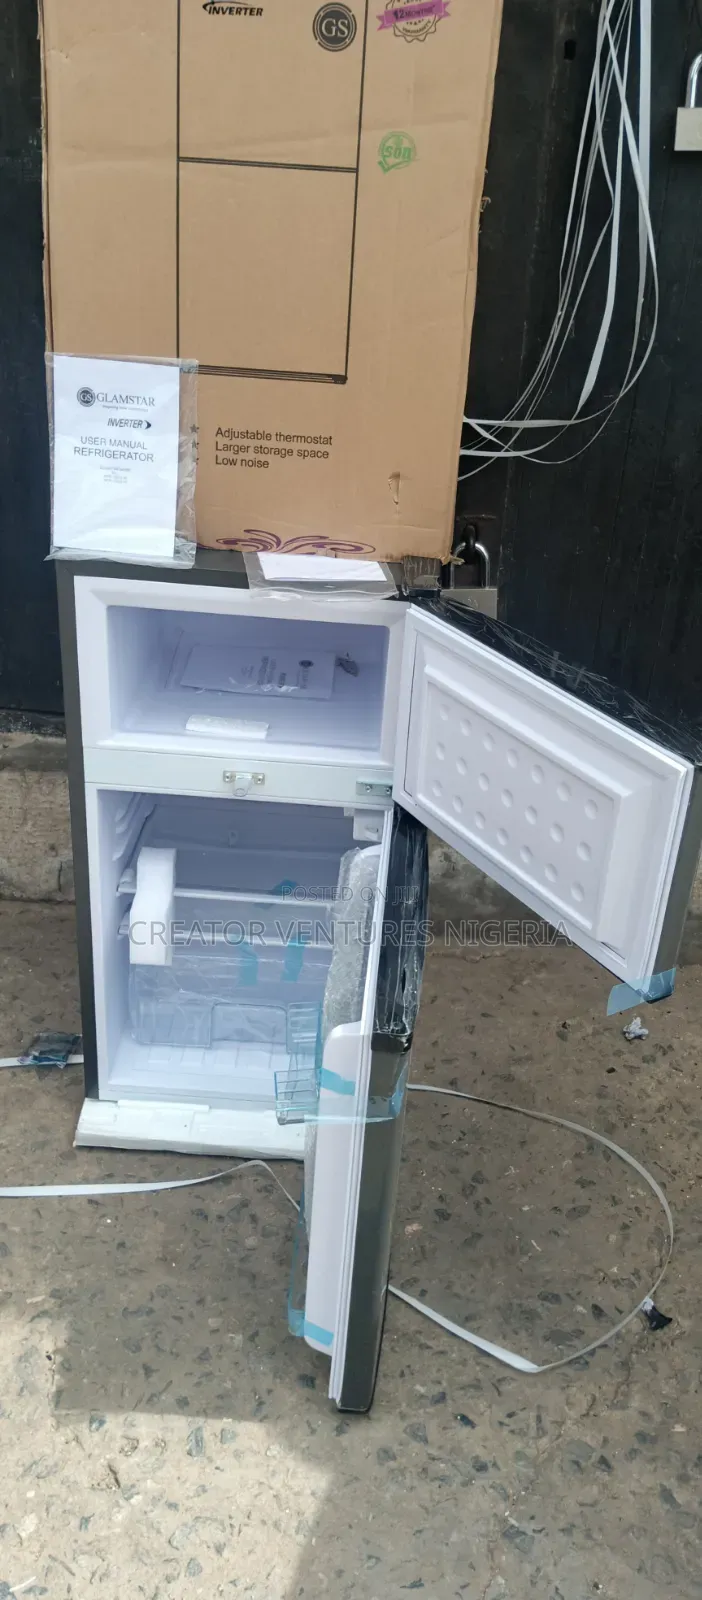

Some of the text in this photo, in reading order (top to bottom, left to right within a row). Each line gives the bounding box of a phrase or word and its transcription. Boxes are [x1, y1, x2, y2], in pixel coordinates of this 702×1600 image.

[208, 6, 264, 17] INVERTER
[321, 18, 349, 38] GS
[96, 392, 155, 407] GLAMSTAR
[107, 417, 143, 429] INVERTER
[80, 436, 148, 450] USER MANUAL
[215, 426, 333, 446] Adjustable thermostat
[73, 446, 154, 463] REFRIGERATOR
[215, 440, 329, 459] Larger storage space
[215, 455, 269, 469] Low noise
